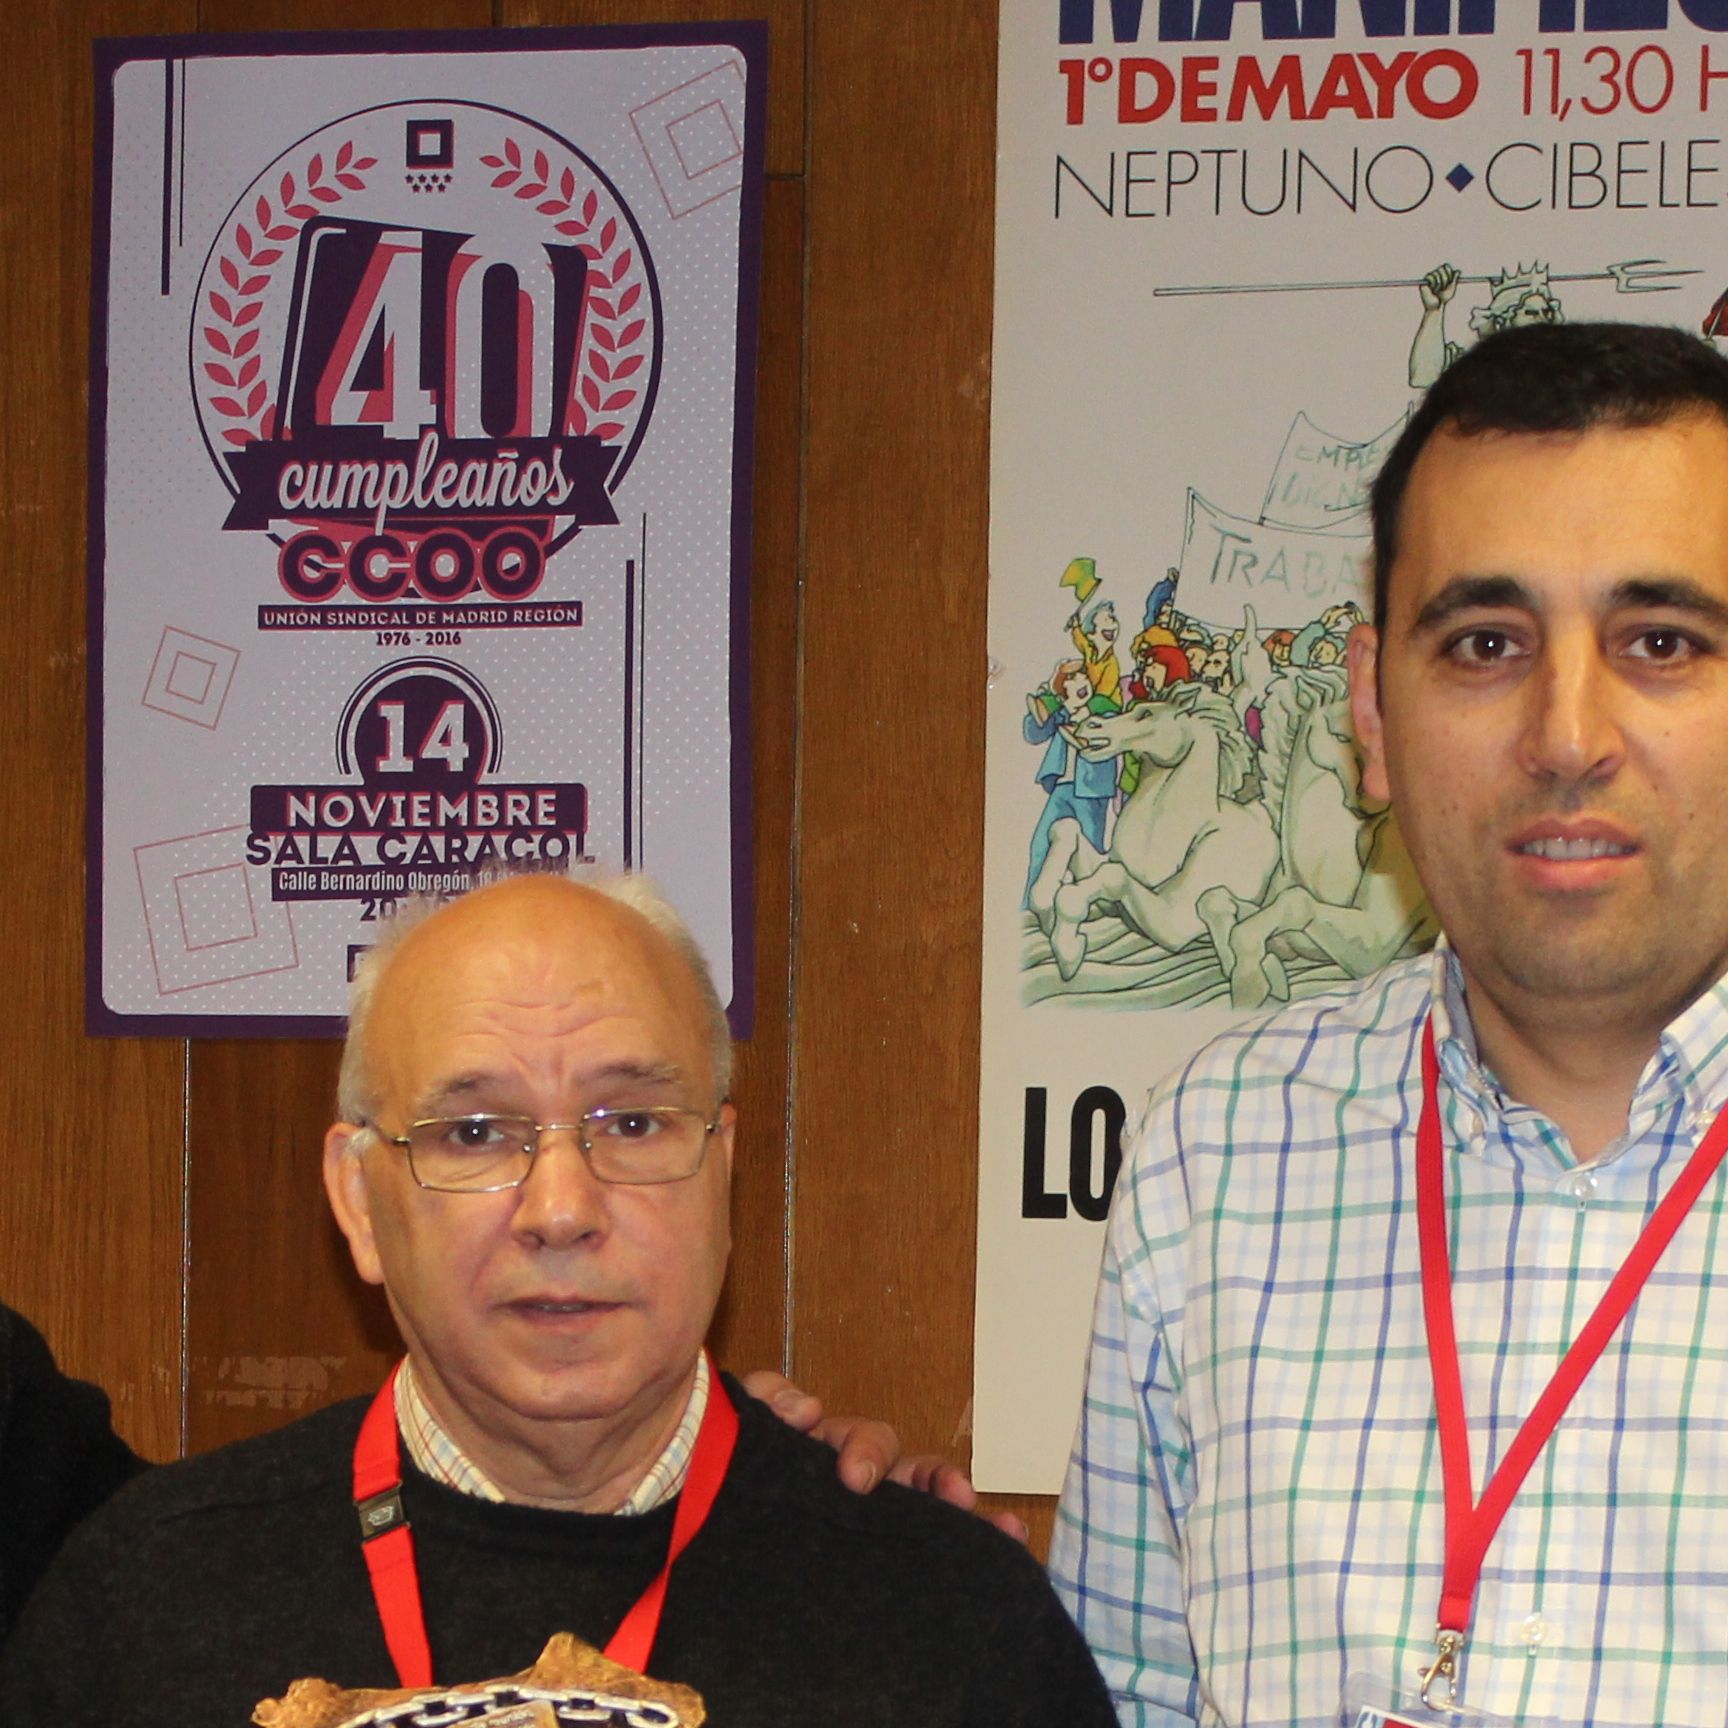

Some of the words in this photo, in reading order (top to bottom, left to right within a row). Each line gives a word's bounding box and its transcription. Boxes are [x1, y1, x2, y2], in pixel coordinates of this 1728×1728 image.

[1117, 55, 1220, 124] DE
[1225, 48, 1480, 122] MAYO
[1515, 44, 1674, 122] 11,30
[1054, 144, 1434, 219] NEPTUNO
[314, 228, 556, 441] 40
[277, 427, 575, 536] cumpleaños
[277, 524, 547, 604] CCOO
[263, 607, 322, 626] UNIÓN
[326, 611, 411, 626] SINDICAL
[416, 610, 437, 625] DE
[442, 609, 509, 625] MADRID
[513, 604, 579, 623] REGIÓN
[376, 631, 412, 646] 1976
[425, 630, 463, 646] 2016
[375, 700, 471, 774] 14
[285, 790, 558, 828] NOVIEMBRE
[245, 832, 363, 866] SALA
[376, 831, 597, 865] CARACOL
[279, 871, 318, 891] Calle
[320, 869, 405, 891] Bernardino
